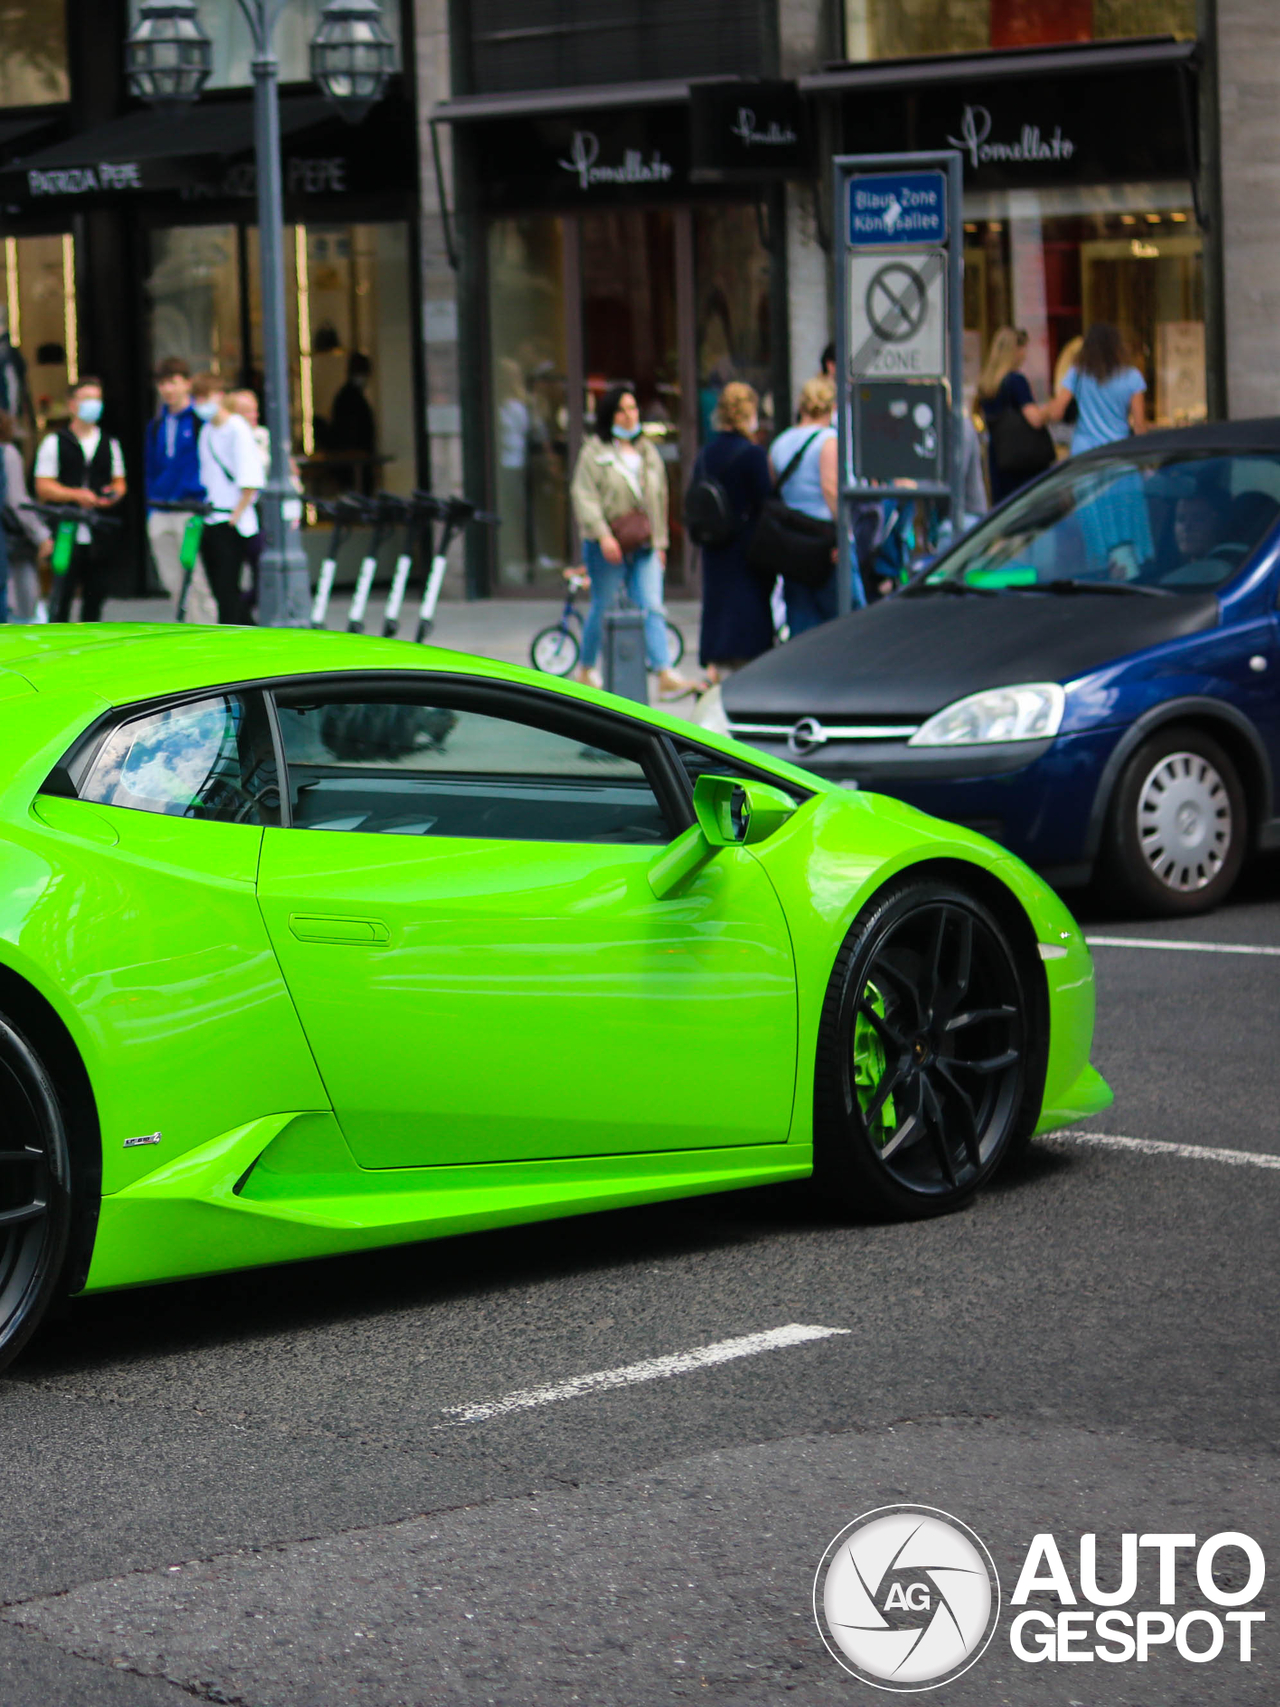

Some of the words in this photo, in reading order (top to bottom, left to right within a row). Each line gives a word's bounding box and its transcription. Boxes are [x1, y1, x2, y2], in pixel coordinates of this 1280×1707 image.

[945, 103, 1073, 168] Pomellato
[557, 131, 672, 190] Pomellato
[901, 187, 937, 207] Zone
[874, 348, 921, 370] ZONE
